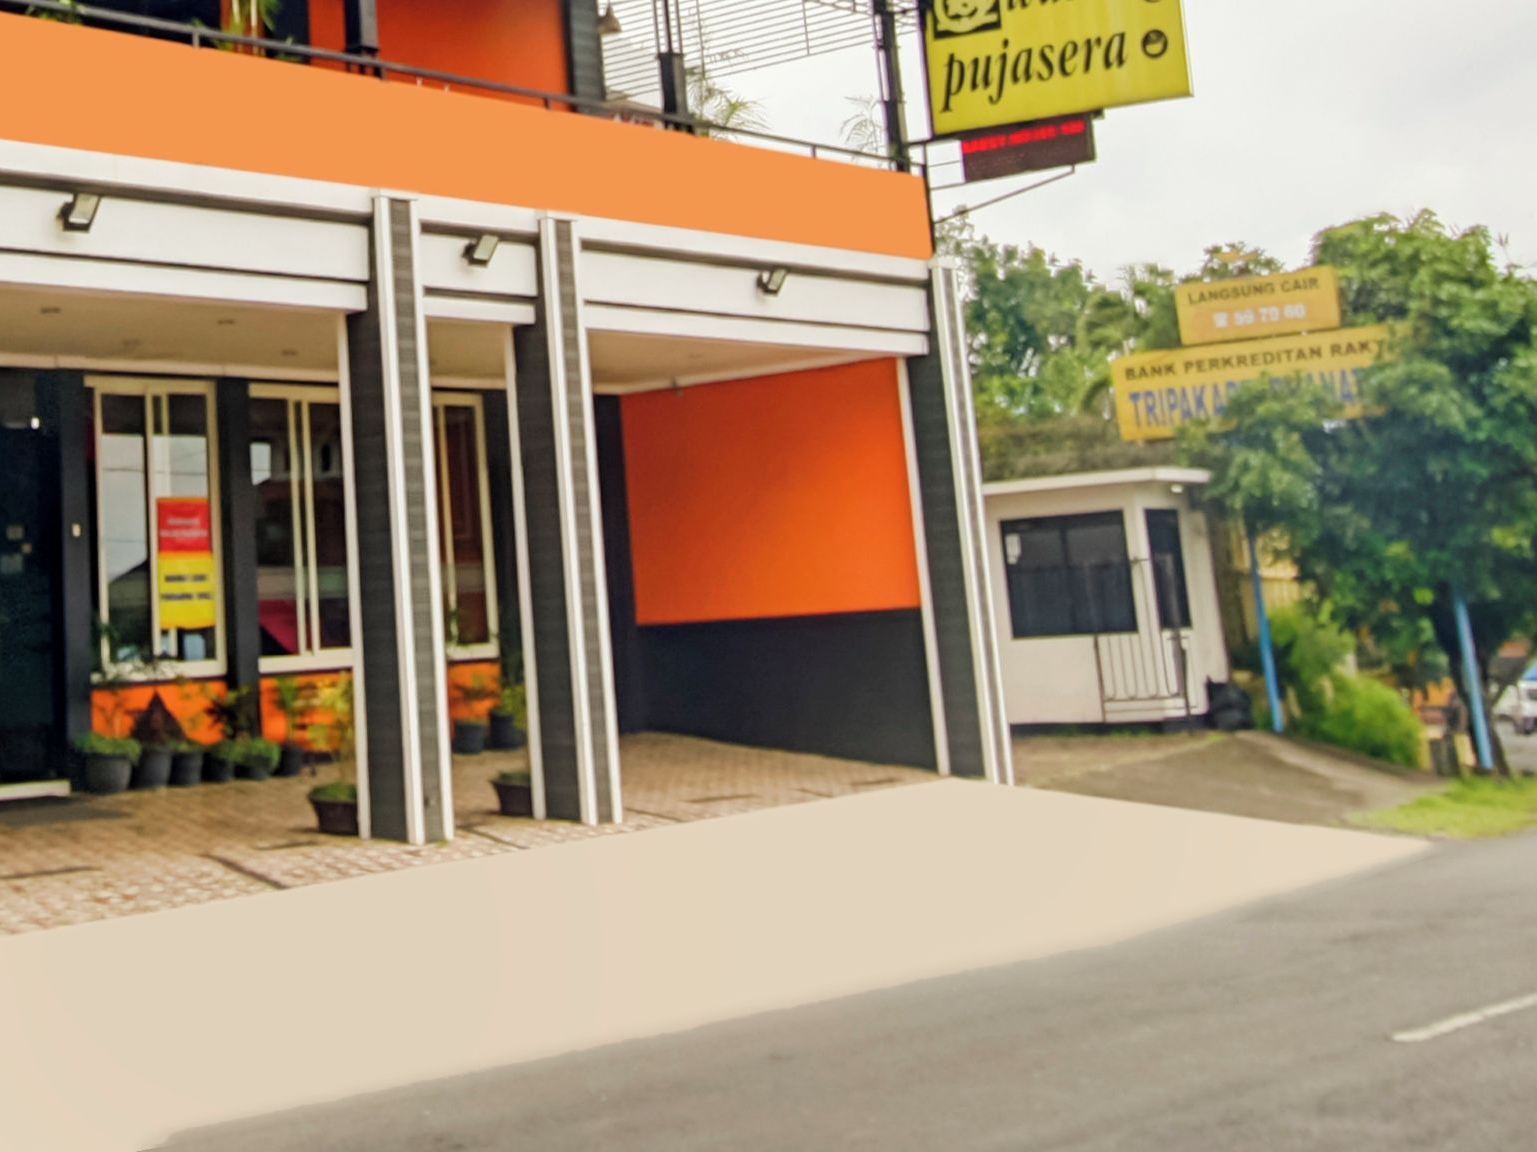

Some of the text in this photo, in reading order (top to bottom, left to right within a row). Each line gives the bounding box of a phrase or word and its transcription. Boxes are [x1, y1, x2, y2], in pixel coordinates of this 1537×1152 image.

[940, 30, 1129, 114] pujasera
[1187, 277, 1320, 304] LANGSUNG CAIR
[1124, 365, 1178, 381] BANK
[1184, 345, 1323, 375] PERKREDITAN
